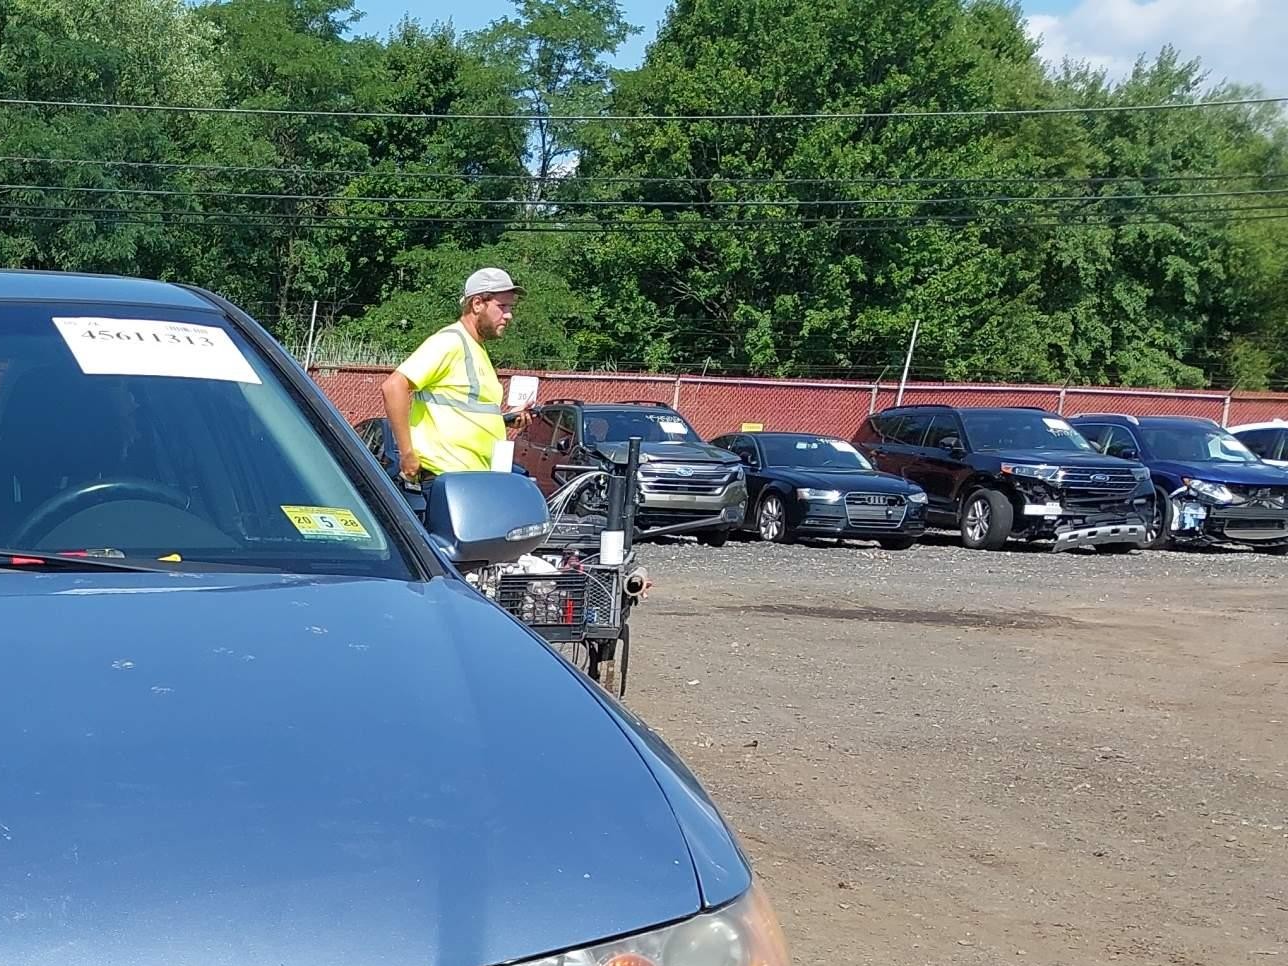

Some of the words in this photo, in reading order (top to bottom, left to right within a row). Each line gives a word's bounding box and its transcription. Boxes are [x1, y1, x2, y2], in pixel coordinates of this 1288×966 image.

[81, 330, 215, 347] 45611313
[294, 516, 312, 525] 20
[320, 516, 334, 528] 5
[340, 518, 359, 528] 28
